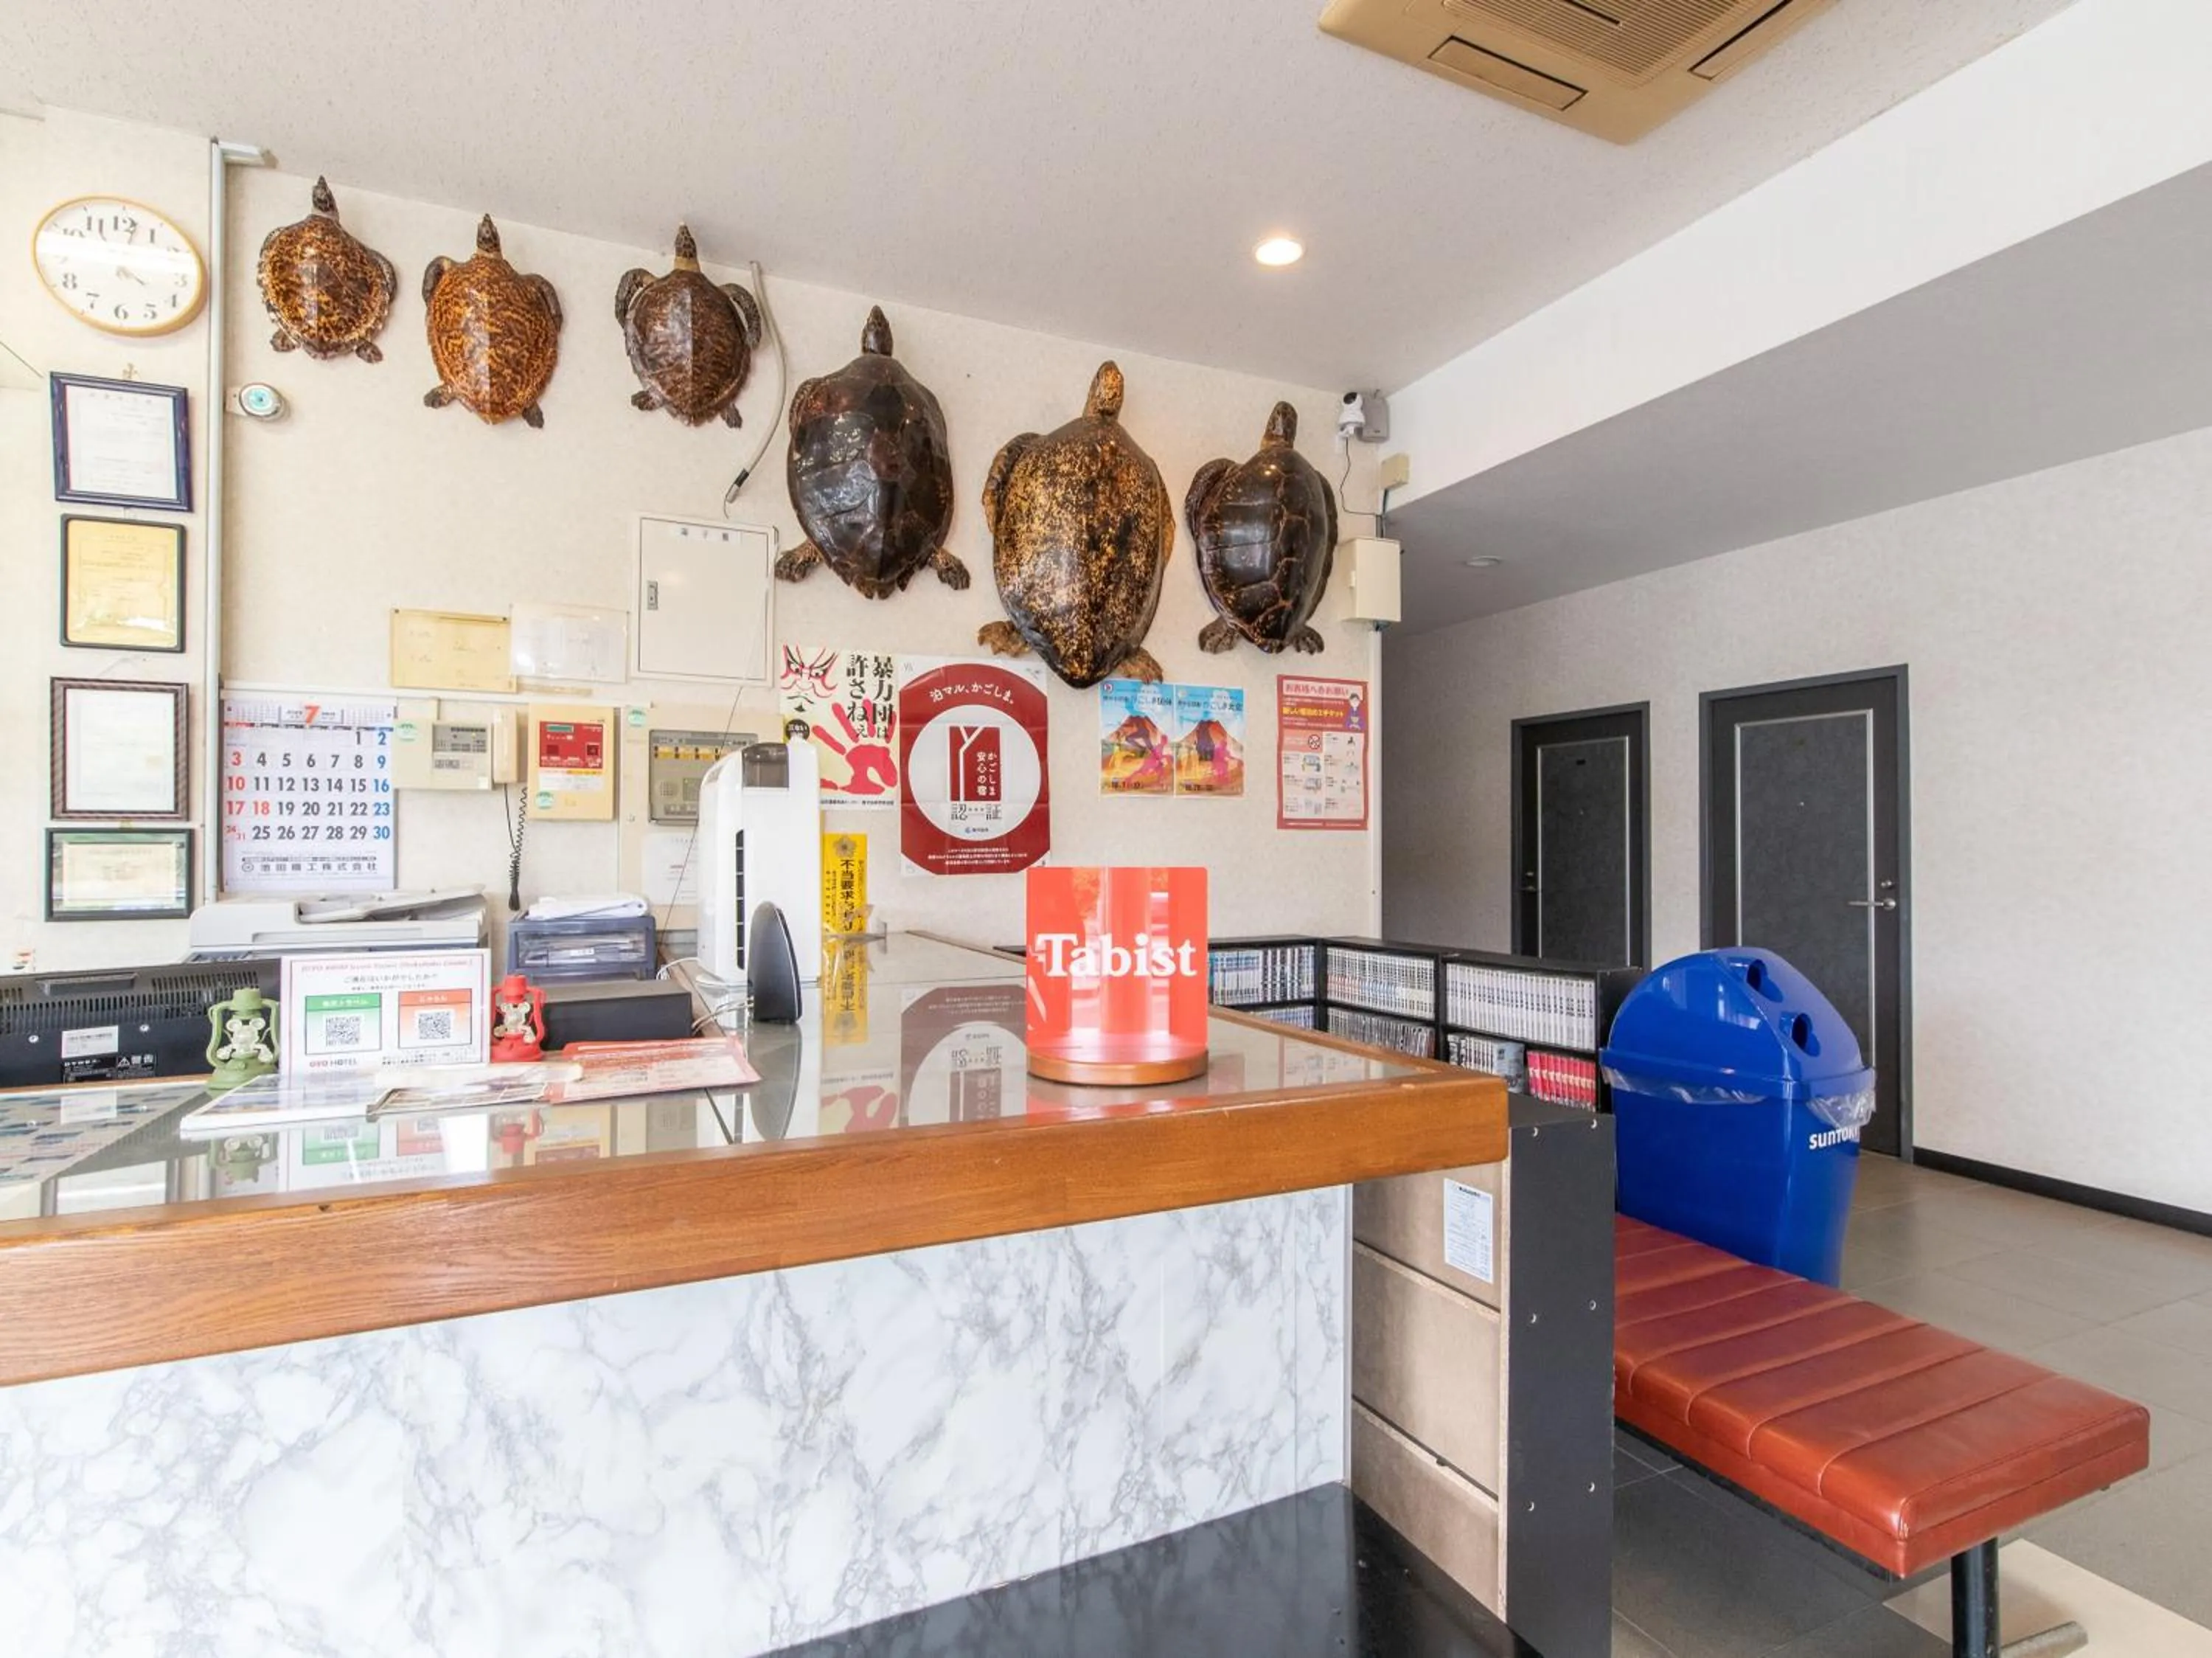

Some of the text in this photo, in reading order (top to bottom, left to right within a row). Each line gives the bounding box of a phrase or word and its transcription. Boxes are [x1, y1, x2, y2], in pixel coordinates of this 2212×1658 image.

[63, 272, 77, 290] 8
[114, 304, 129, 320] 6
[305, 705, 320, 724] 7
[356, 732, 386, 746] 1 2
[232, 752, 386, 769] 3 4 5 6 7 8 9
[227, 777, 389, 792] 10 11 12 13 14 15 16
[227, 802, 390, 816] 17 18 19 20 21 22 23
[253, 826, 271, 839] 25
[278, 826, 295, 839] 26
[302, 827, 319, 839] 27
[327, 827, 343, 839] 28
[350, 827, 367, 839] 29
[374, 827, 390, 839] 30
[1035, 932, 1198, 977] Tabist
